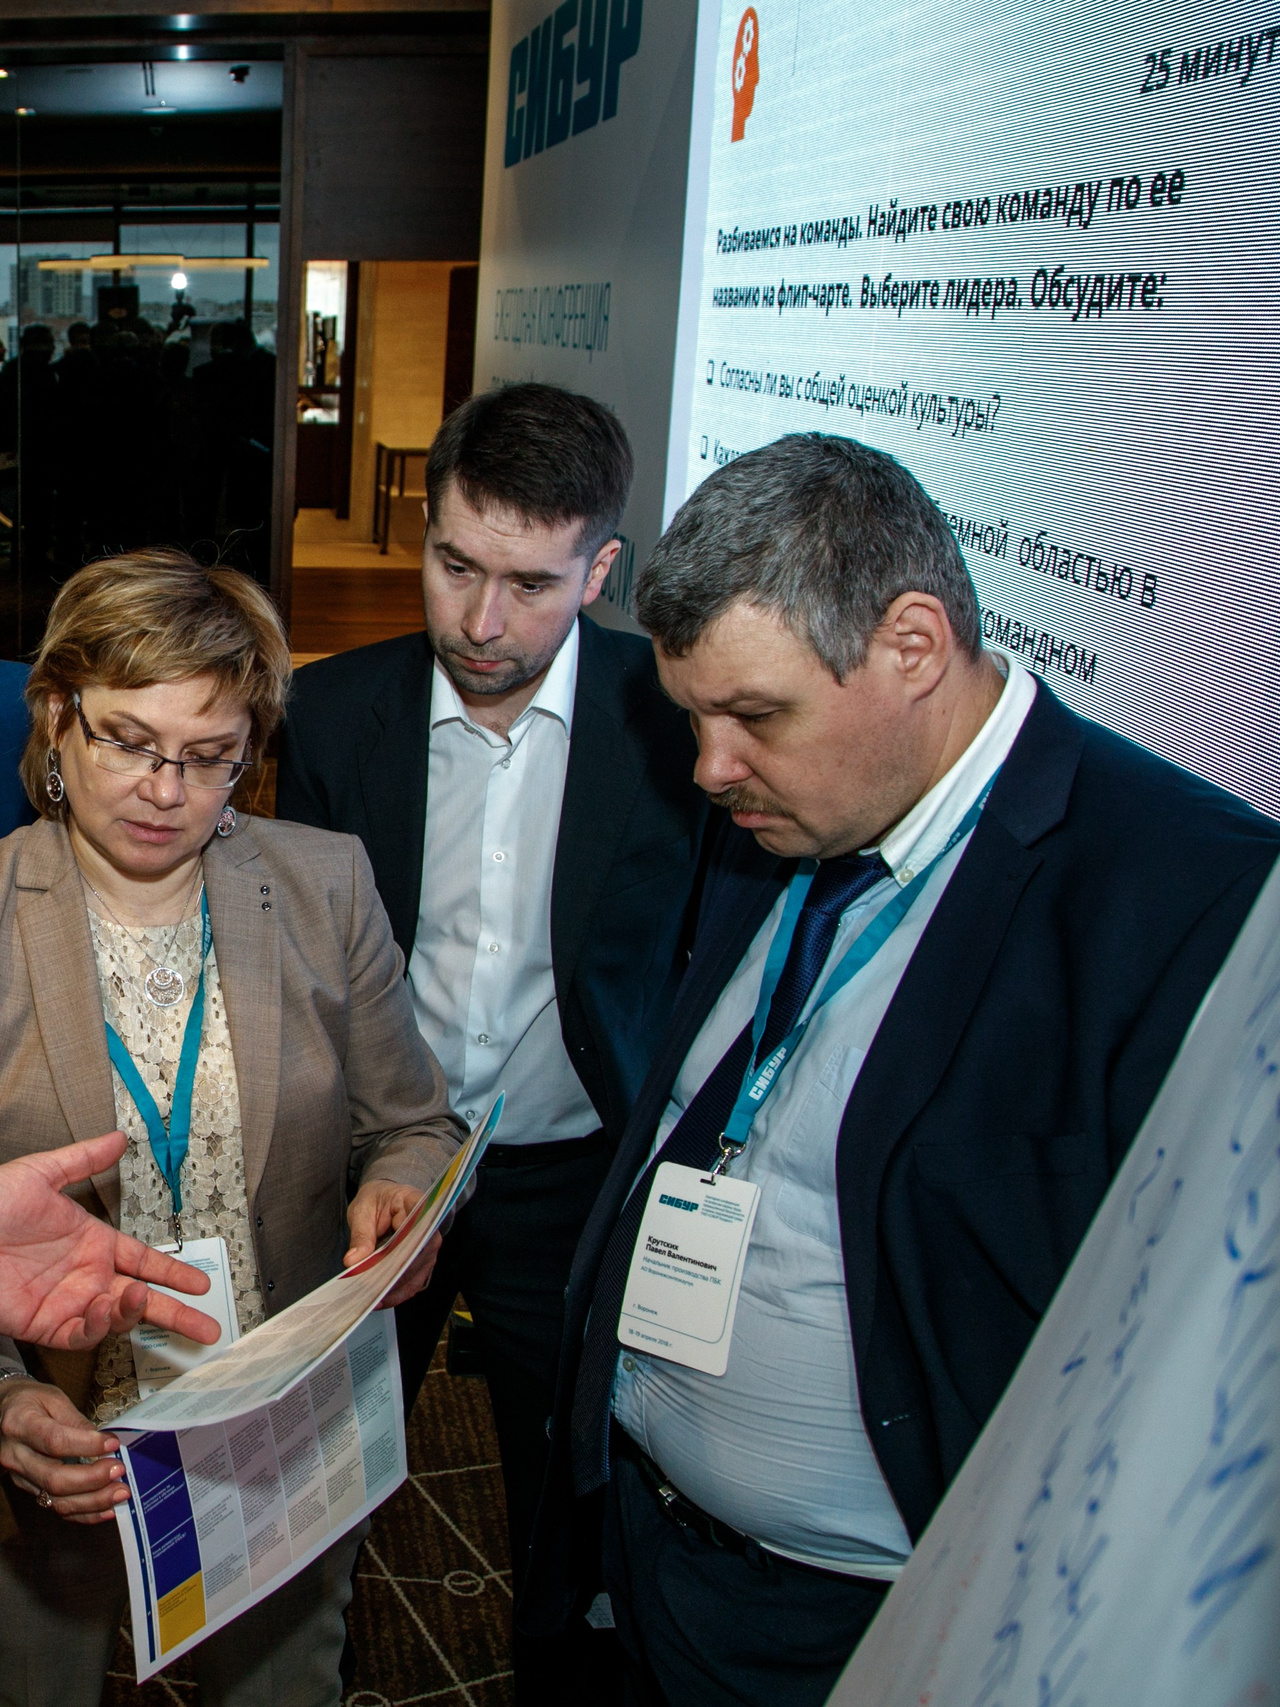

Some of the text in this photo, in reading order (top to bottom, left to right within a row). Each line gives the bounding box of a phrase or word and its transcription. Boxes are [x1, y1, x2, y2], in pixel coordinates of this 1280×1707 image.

[504, 0, 643, 169] СИБУР
[1140, 27, 1280, 93] 25 минут
[717, 168, 1185, 254] Разбиваемся на команды. Найдите свою команду по ее
[538, 281, 611, 363] КОНФЕРЕНЦИЯ
[712, 265, 1167, 322] названию на флип-чарте. Выберите лидера. Обсудите:
[720, 361, 1001, 438] Согласны ли вы с общей оценкой культуры?
[1019, 530, 1133, 600] областью
[1140, 572, 1157, 609] в
[748, 1046, 787, 1100] СИБУР
[659, 1193, 699, 1212] СИБУР
[646, 1243, 717, 1271] Павел Валентинович
[647, 1235, 679, 1251] Крутских
[671, 1265, 709, 1282] производства
